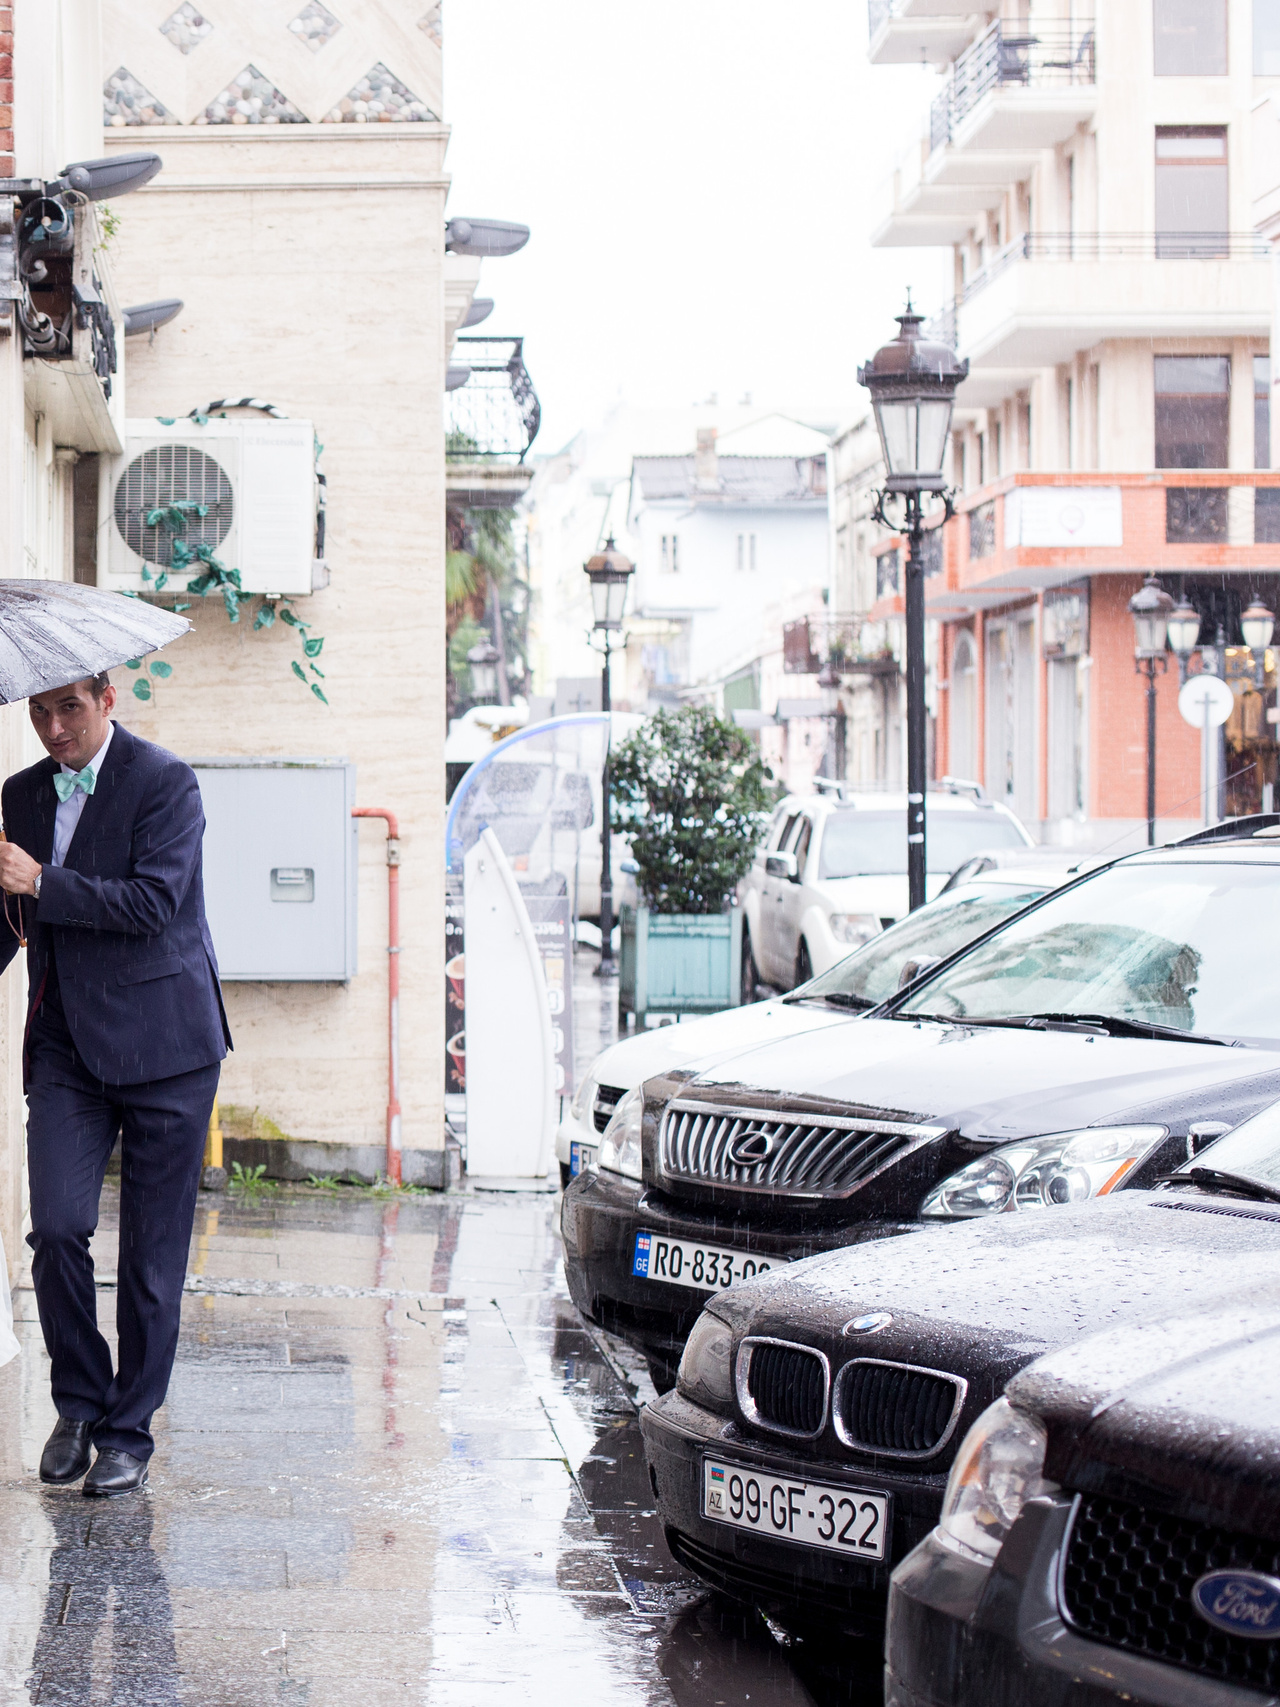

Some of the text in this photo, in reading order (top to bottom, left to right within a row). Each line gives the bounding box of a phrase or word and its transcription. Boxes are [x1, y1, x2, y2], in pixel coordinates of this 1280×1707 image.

[636, 1257, 648, 1272] GE
[709, 1492, 722, 1509] AZ
[729, 1474, 879, 1550] 99-GF-322
[1213, 1580, 1279, 1627] Ford
